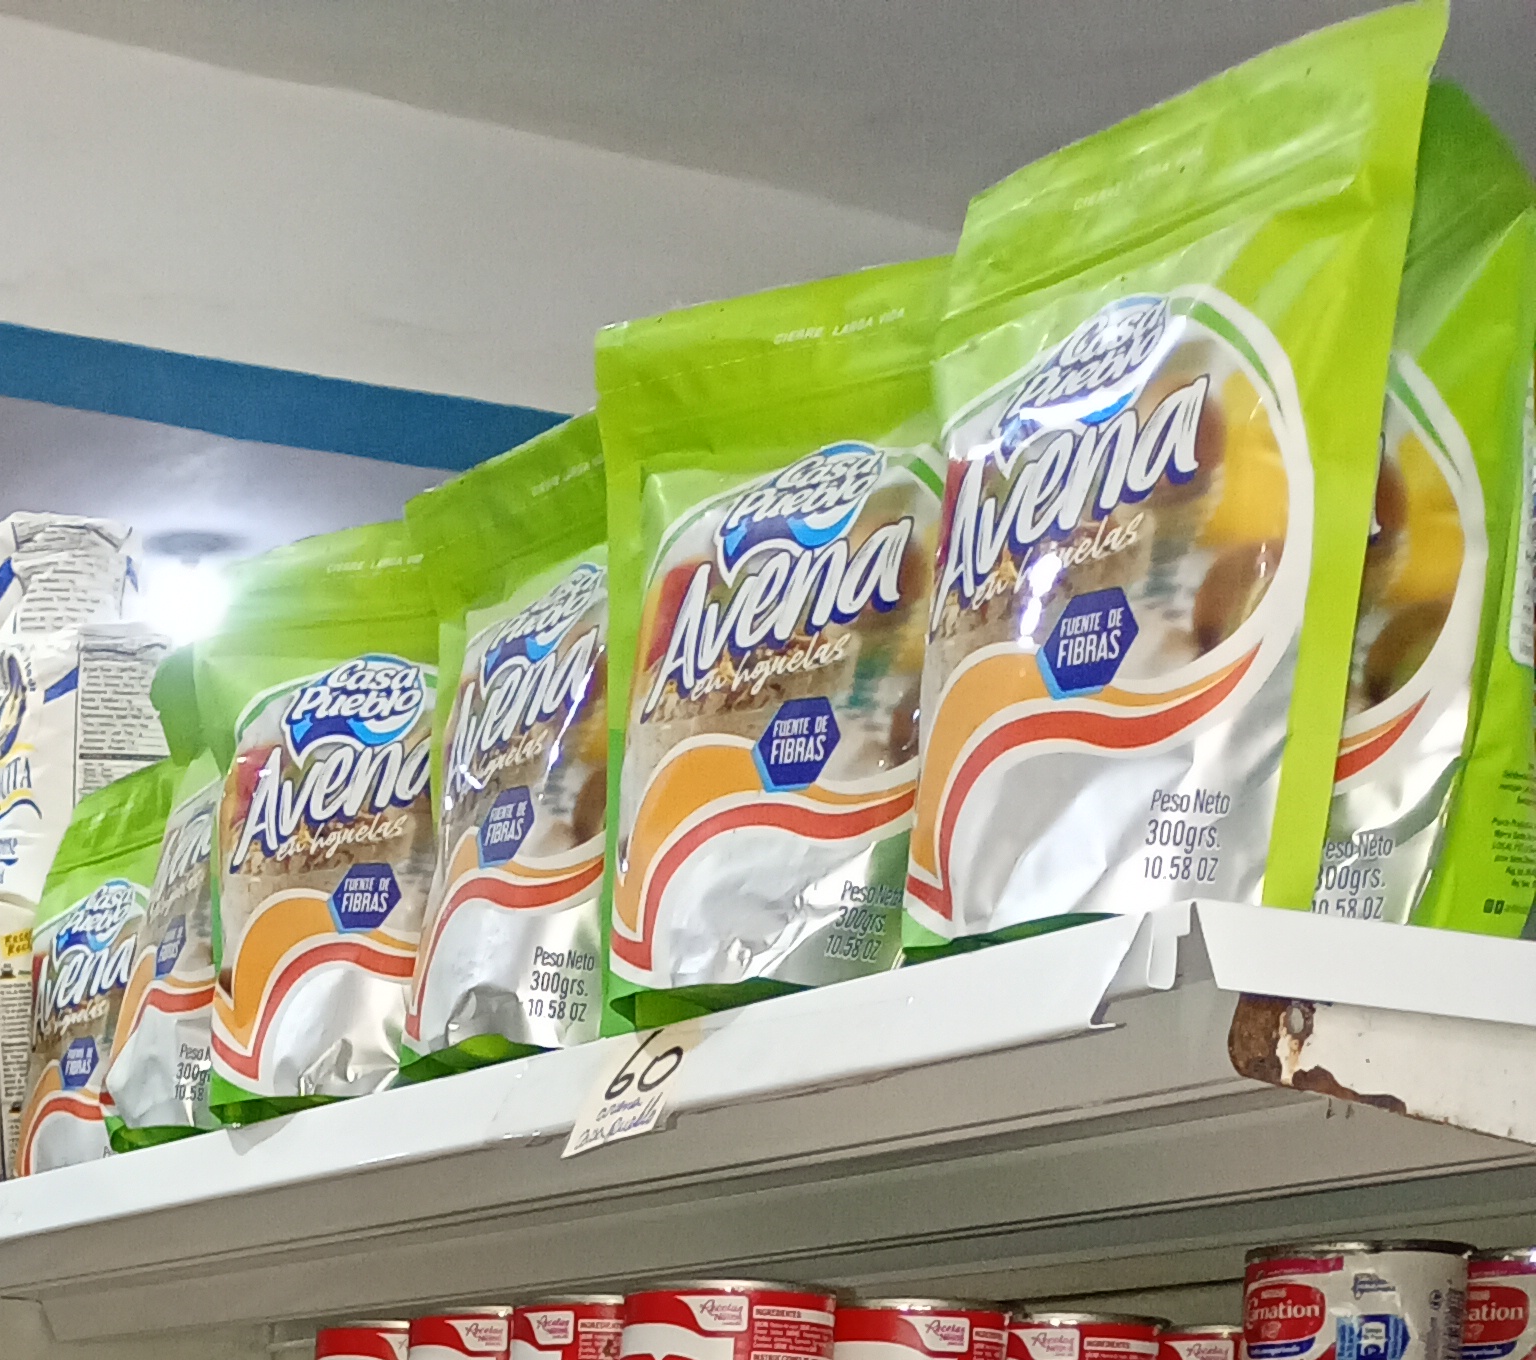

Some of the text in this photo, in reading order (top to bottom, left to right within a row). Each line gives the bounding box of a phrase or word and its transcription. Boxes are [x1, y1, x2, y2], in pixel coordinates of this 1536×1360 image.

[775, 448, 883, 492] Casa
[720, 468, 884, 529] Pueblo
[930, 375, 1209, 631] Avena
[642, 517, 913, 716] Avena
[1060, 607, 1124, 637] FUENTE DE
[1057, 631, 1121, 668] FIBRAS
[327, 660, 418, 692] Casa
[290, 684, 422, 720] Pueblo
[773, 716, 829, 741] FUENTE DE
[770, 734, 827, 766] FIBRAS
[517, 801, 528, 816] DE
[1150, 790, 1230, 815] Peso Neto
[484, 817, 525, 846] FIBRAS
[1145, 818, 1221, 854] 300grs.
[1143, 852, 1219, 882] 10.58 OZ
[378, 877, 390, 892] DE
[842, 880, 873, 903] Peso
[340, 891, 388, 915] FIBRAS
[533, 947, 595, 971] Peso Neto
[530, 971, 589, 998] 300grs.
[569, 1002, 587, 1023] OZ
[605, 1028, 683, 1100] 60
